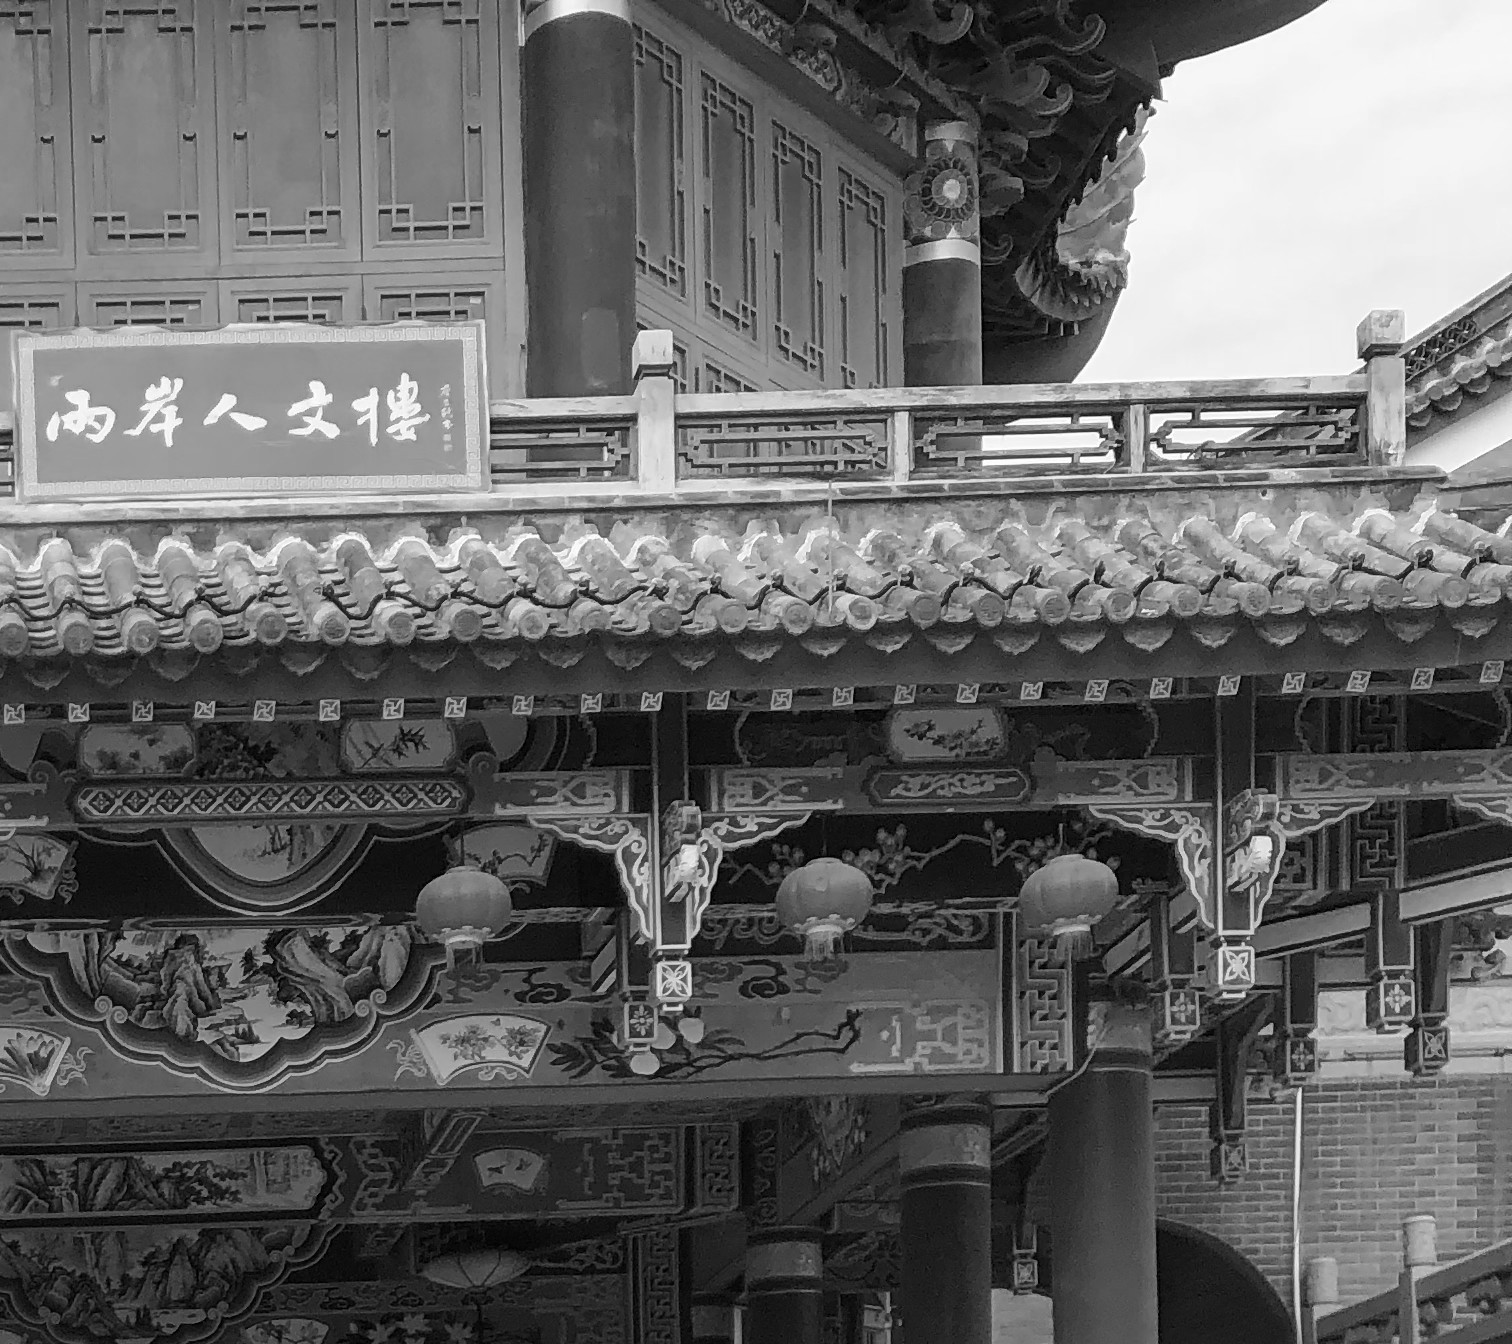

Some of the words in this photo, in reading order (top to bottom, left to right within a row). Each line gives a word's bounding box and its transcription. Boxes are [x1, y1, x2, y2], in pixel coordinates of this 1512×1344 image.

[45, 372, 431, 448] 兩岸人文樓
